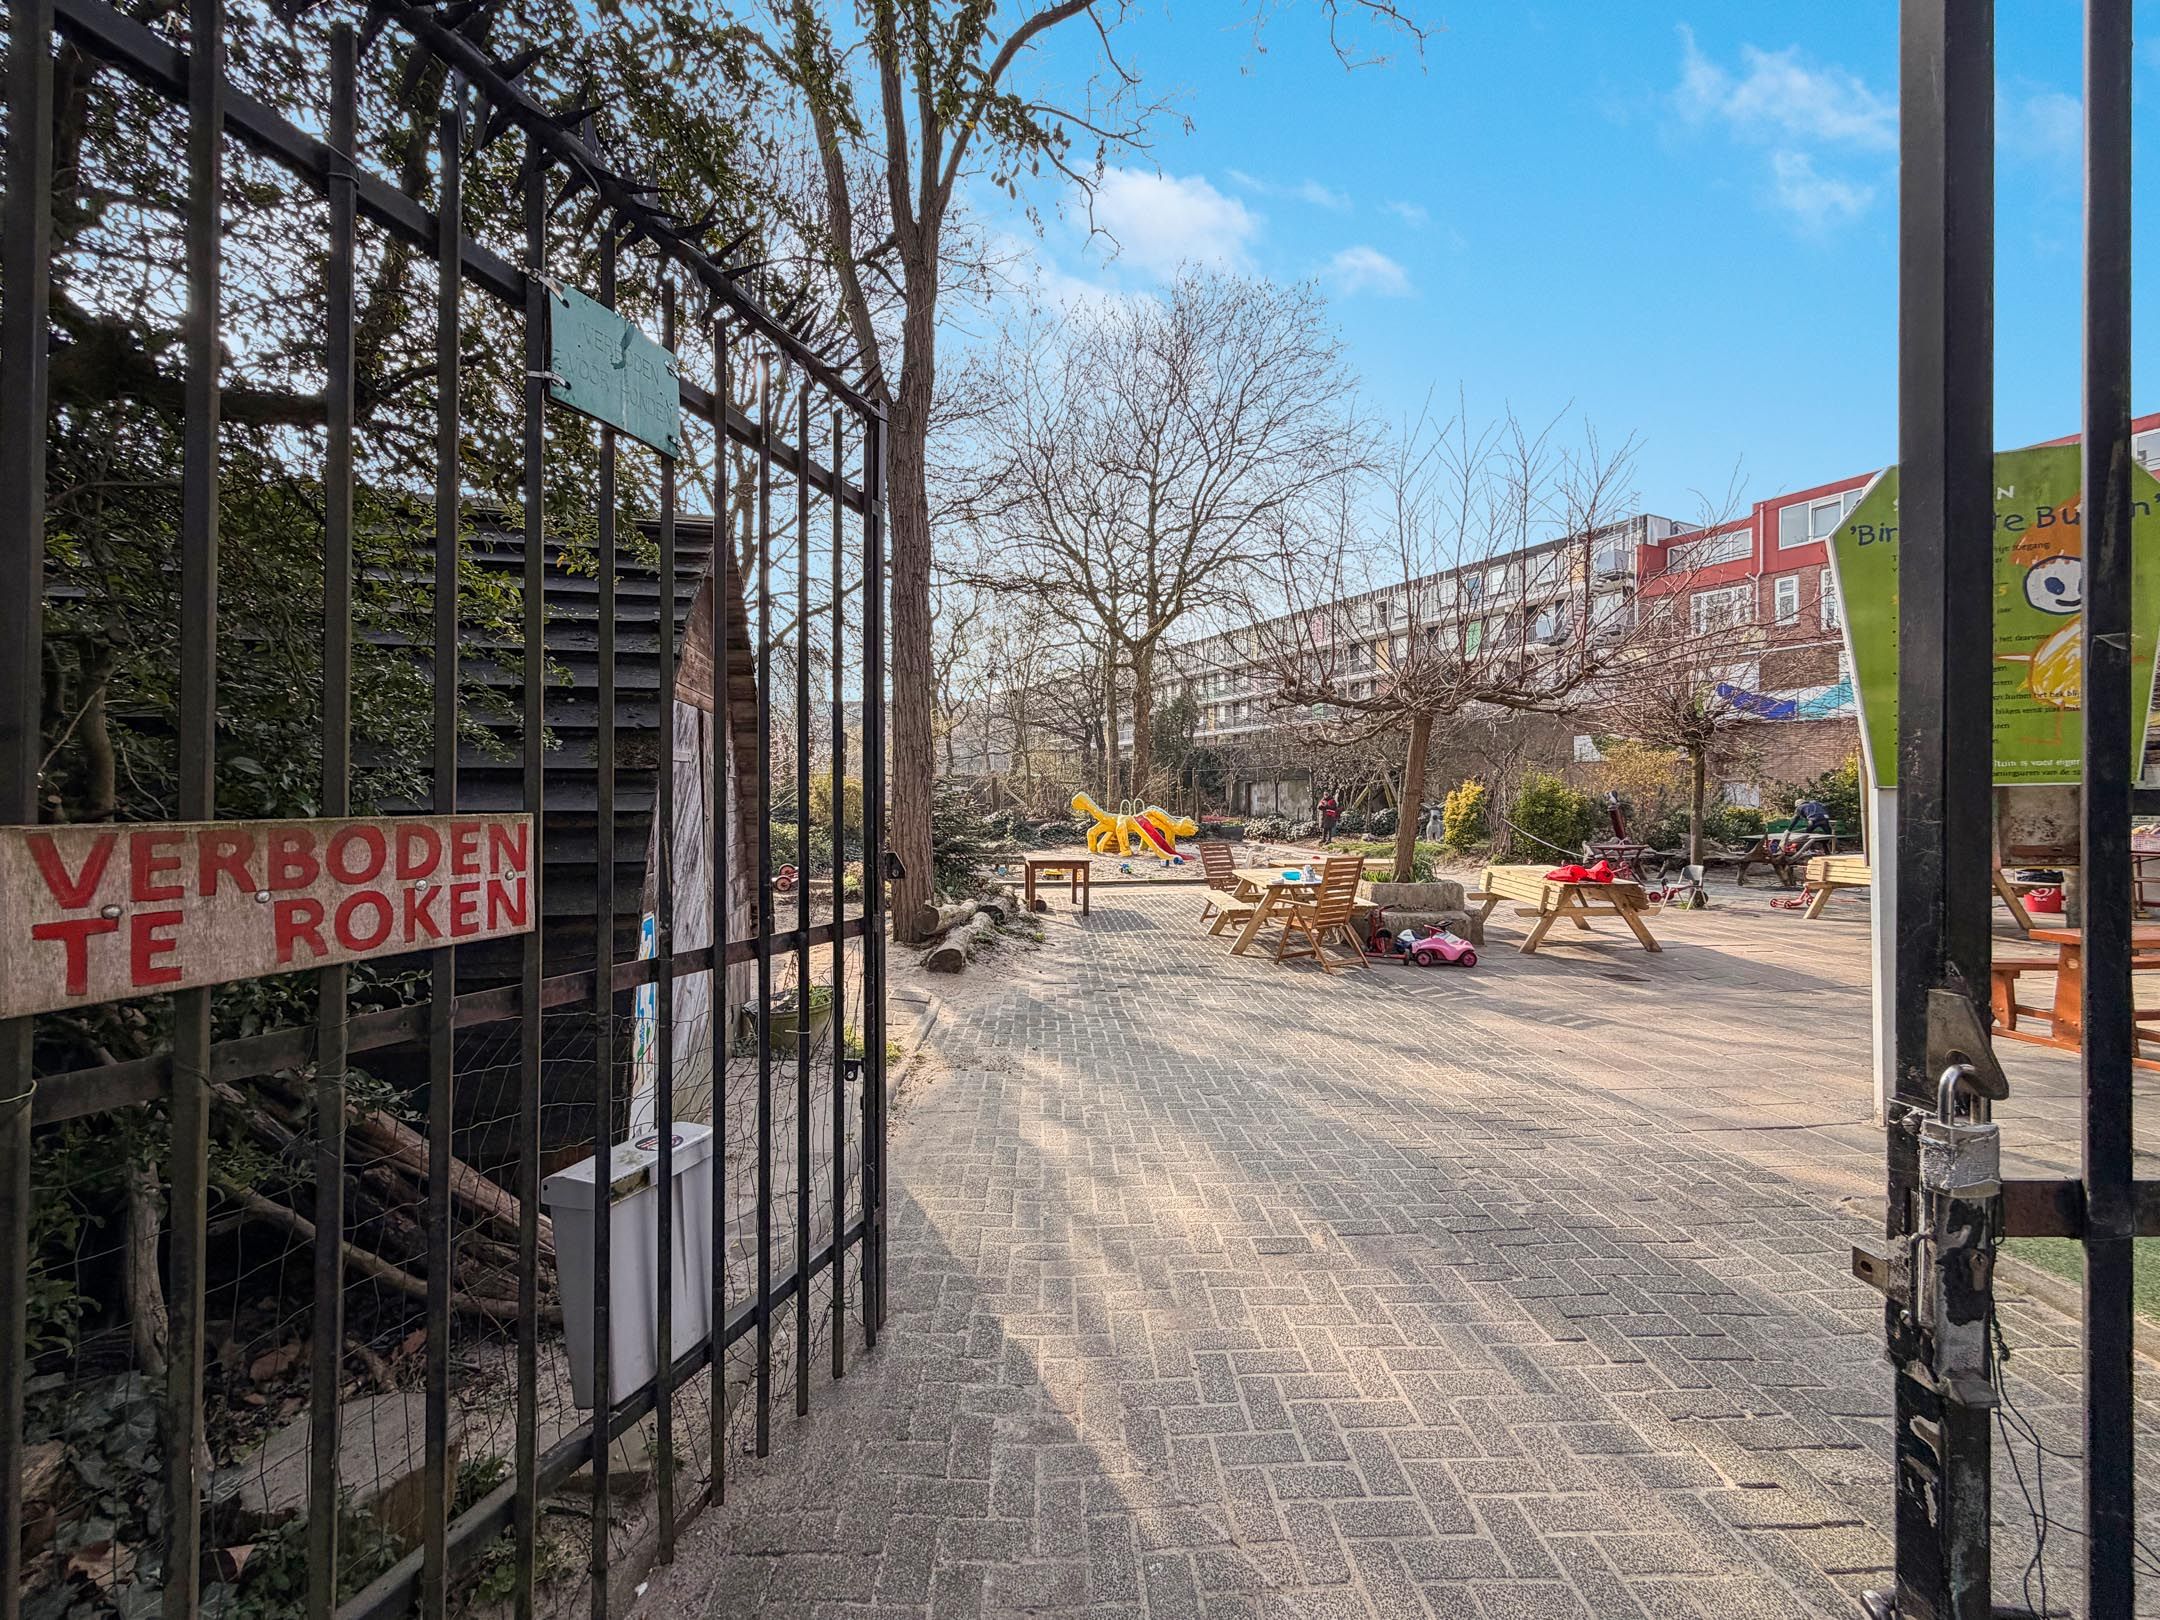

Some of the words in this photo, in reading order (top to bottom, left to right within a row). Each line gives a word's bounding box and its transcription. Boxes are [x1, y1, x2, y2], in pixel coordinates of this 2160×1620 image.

[567, 352, 610, 392] VOOR
[26, 822, 528, 910] VERBODEN
[32, 909, 184, 997] TE
[273, 876, 528, 964] ROKEN
